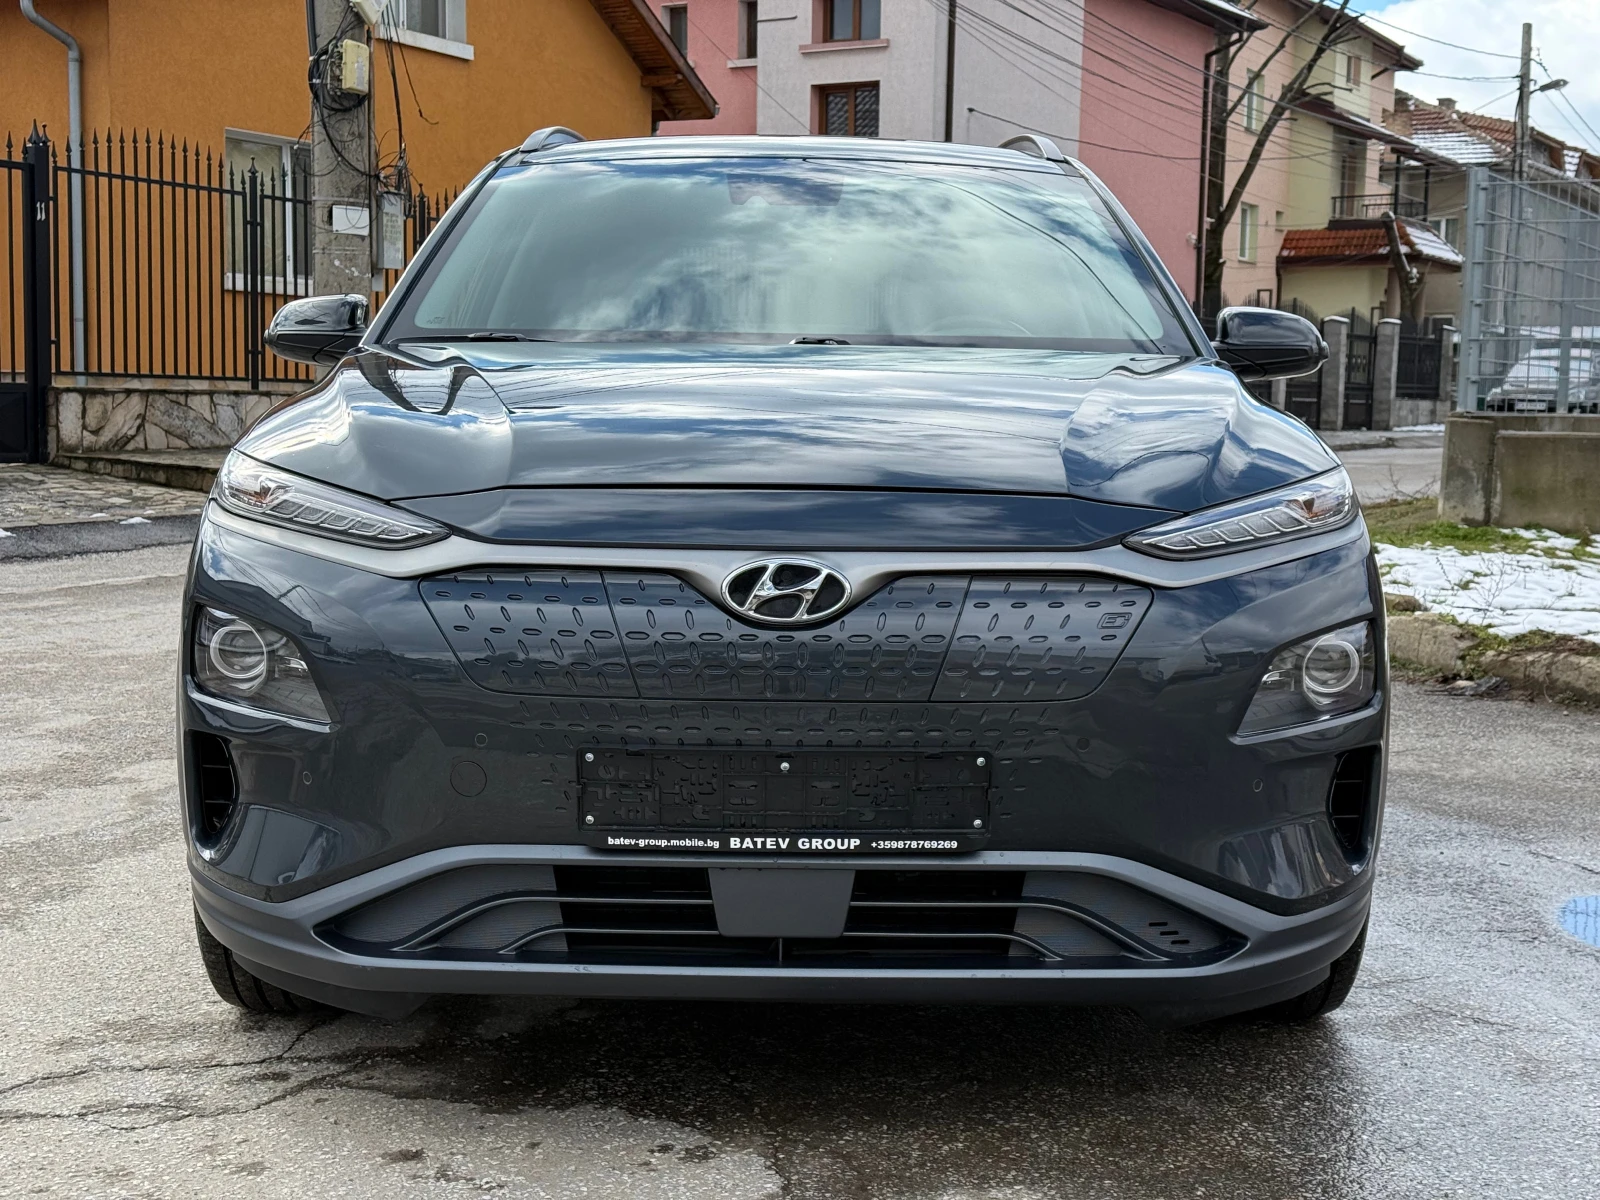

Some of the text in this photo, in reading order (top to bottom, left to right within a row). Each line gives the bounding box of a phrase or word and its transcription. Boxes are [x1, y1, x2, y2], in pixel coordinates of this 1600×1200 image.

[36, 201, 46, 221] 11
[607, 836, 958, 850] batev-group.mobile.bg BATEV GROUP +359878769269
